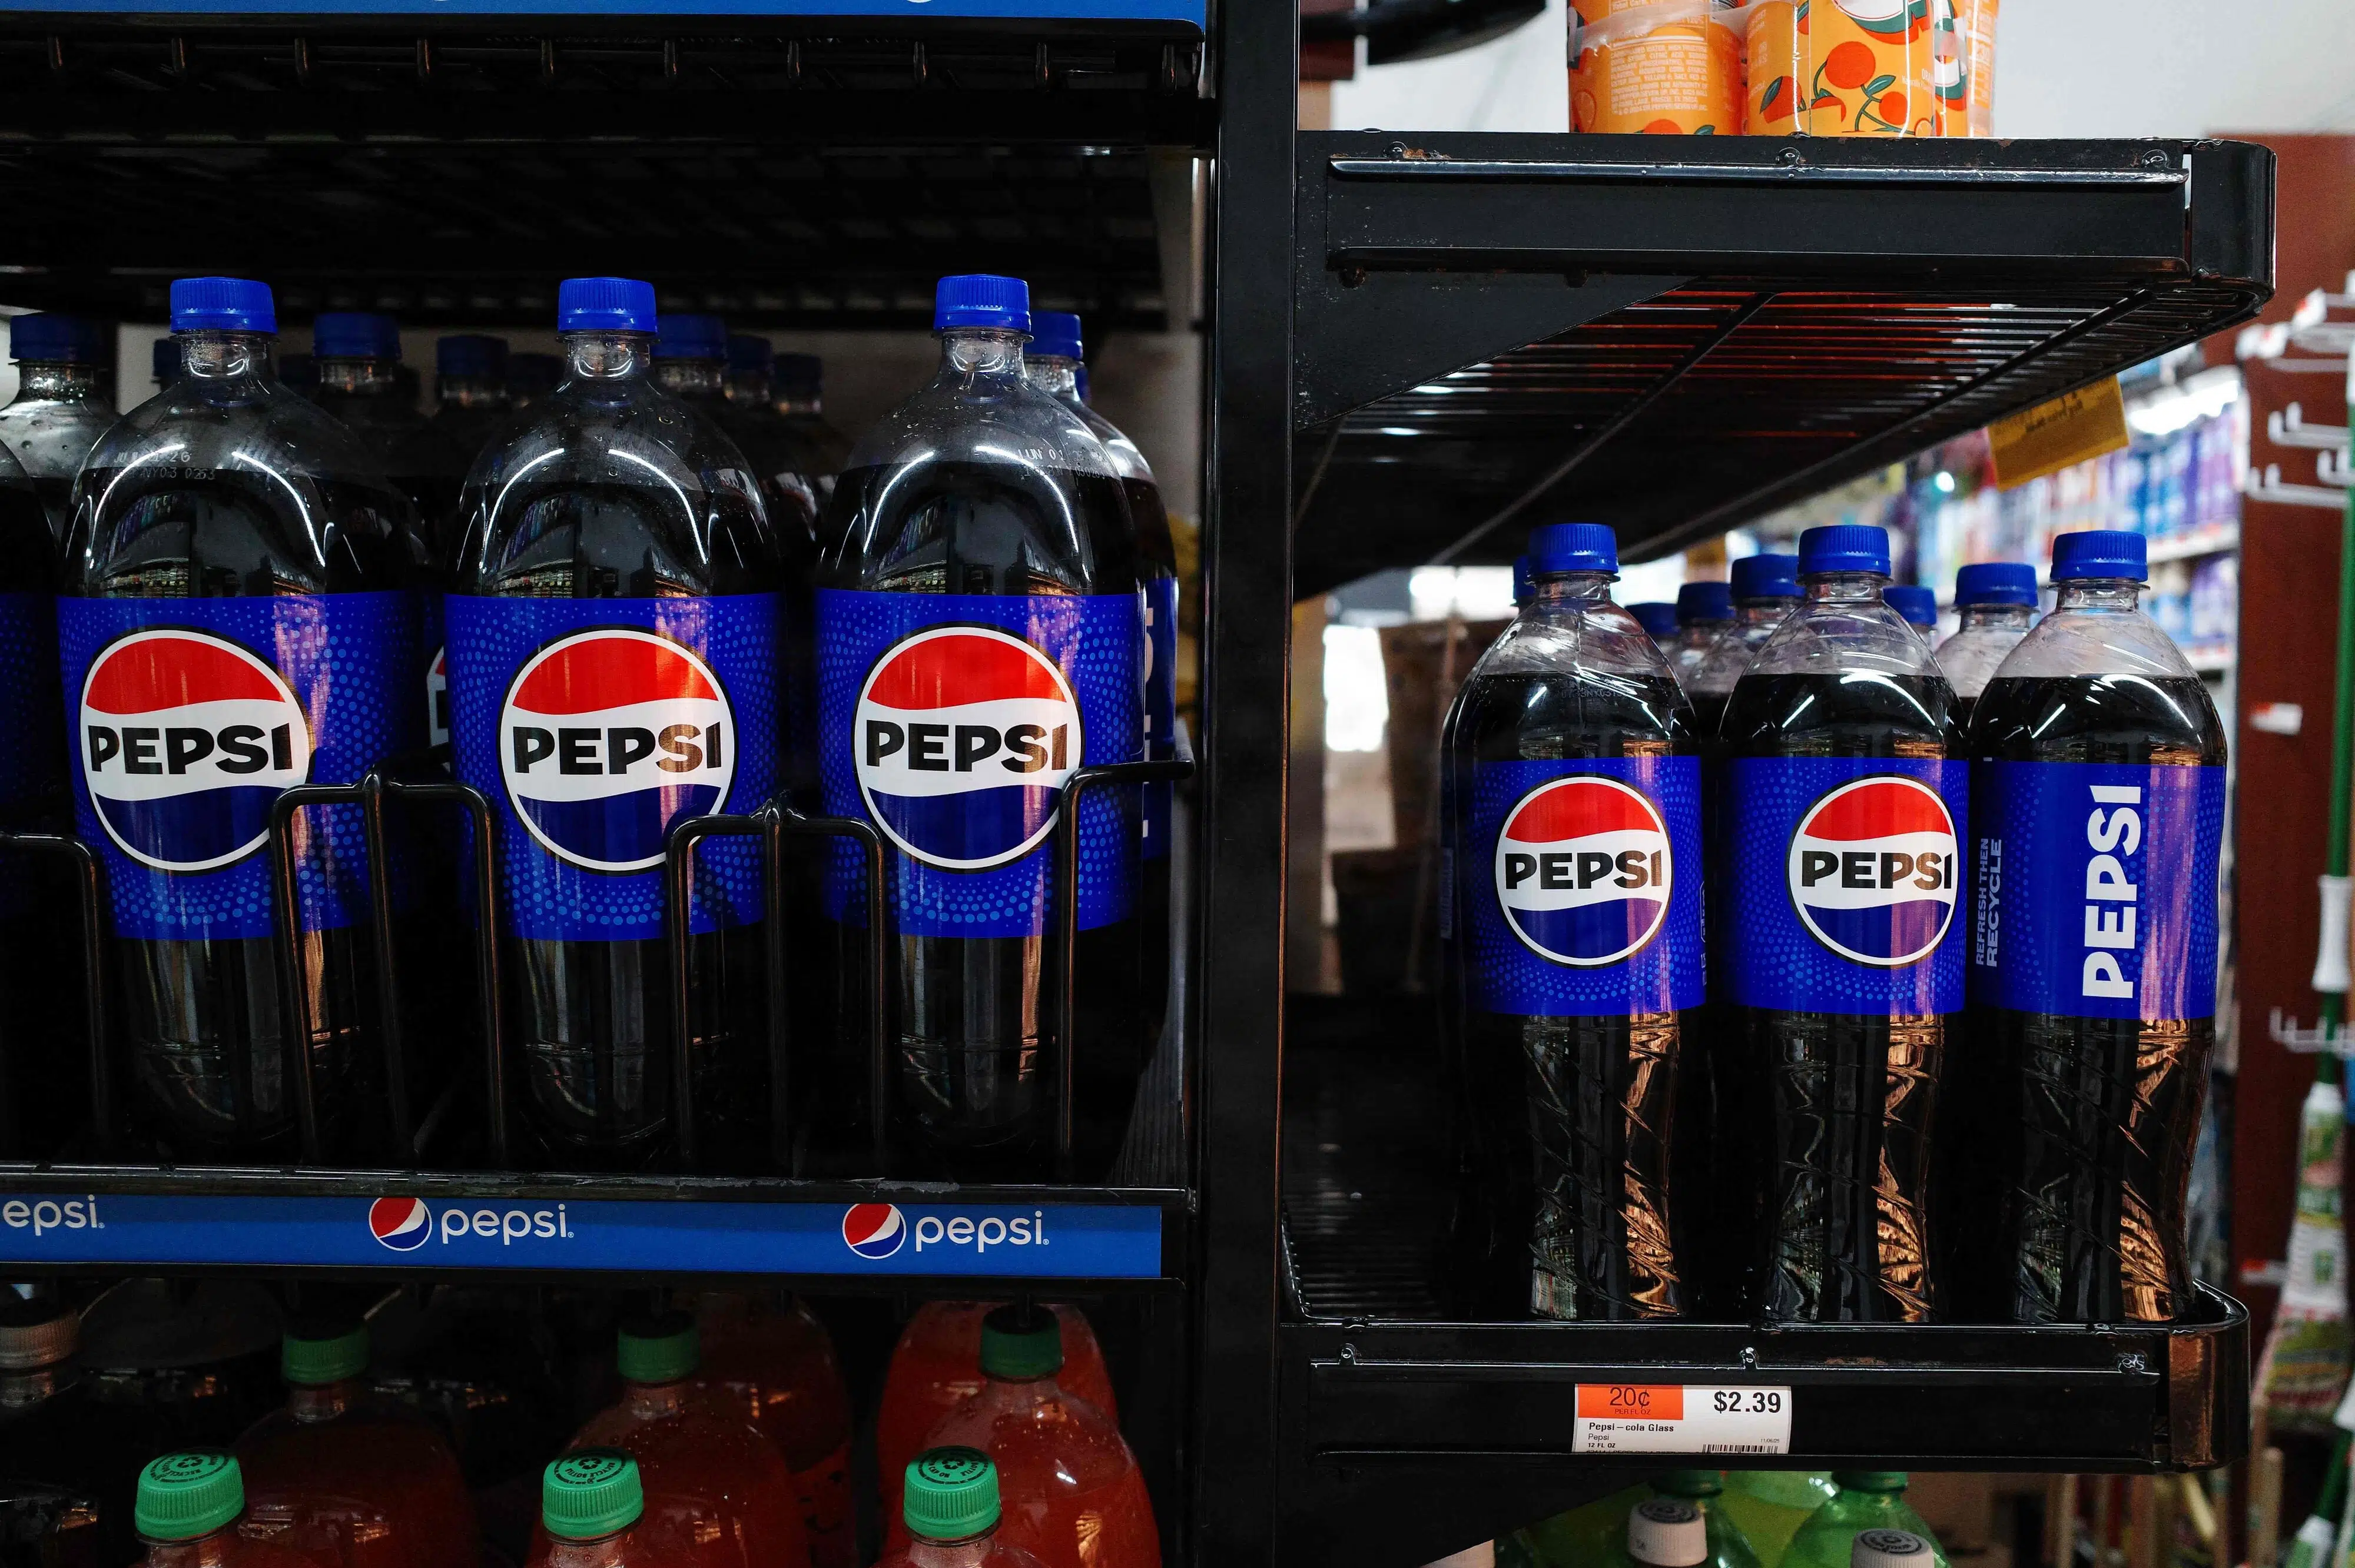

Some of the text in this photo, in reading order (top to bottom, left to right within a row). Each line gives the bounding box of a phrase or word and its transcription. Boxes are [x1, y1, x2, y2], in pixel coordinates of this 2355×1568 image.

[88, 723, 293, 774] PEPSI
[513, 722, 721, 775] PEPSI
[866, 720, 1067, 773] PEPSI
[1505, 850, 1663, 890] PEPSI
[1802, 851, 1952, 890] PEPSI
[1976, 838, 1989, 965] REFRESH THEN
[1986, 839, 2002, 967] RECYCLE
[2082, 786, 2141, 998] PEPSI
[441, 1204, 566, 1245] pepsi
[916, 1210, 1043, 1253] pepsi
[1610, 1387, 1650, 1408] 20¢
[1714, 1390, 1781, 1414] $2.39
[1588, 1433, 1609, 1441] Pepsi
[1648, 1424, 1674, 1432] Glass
